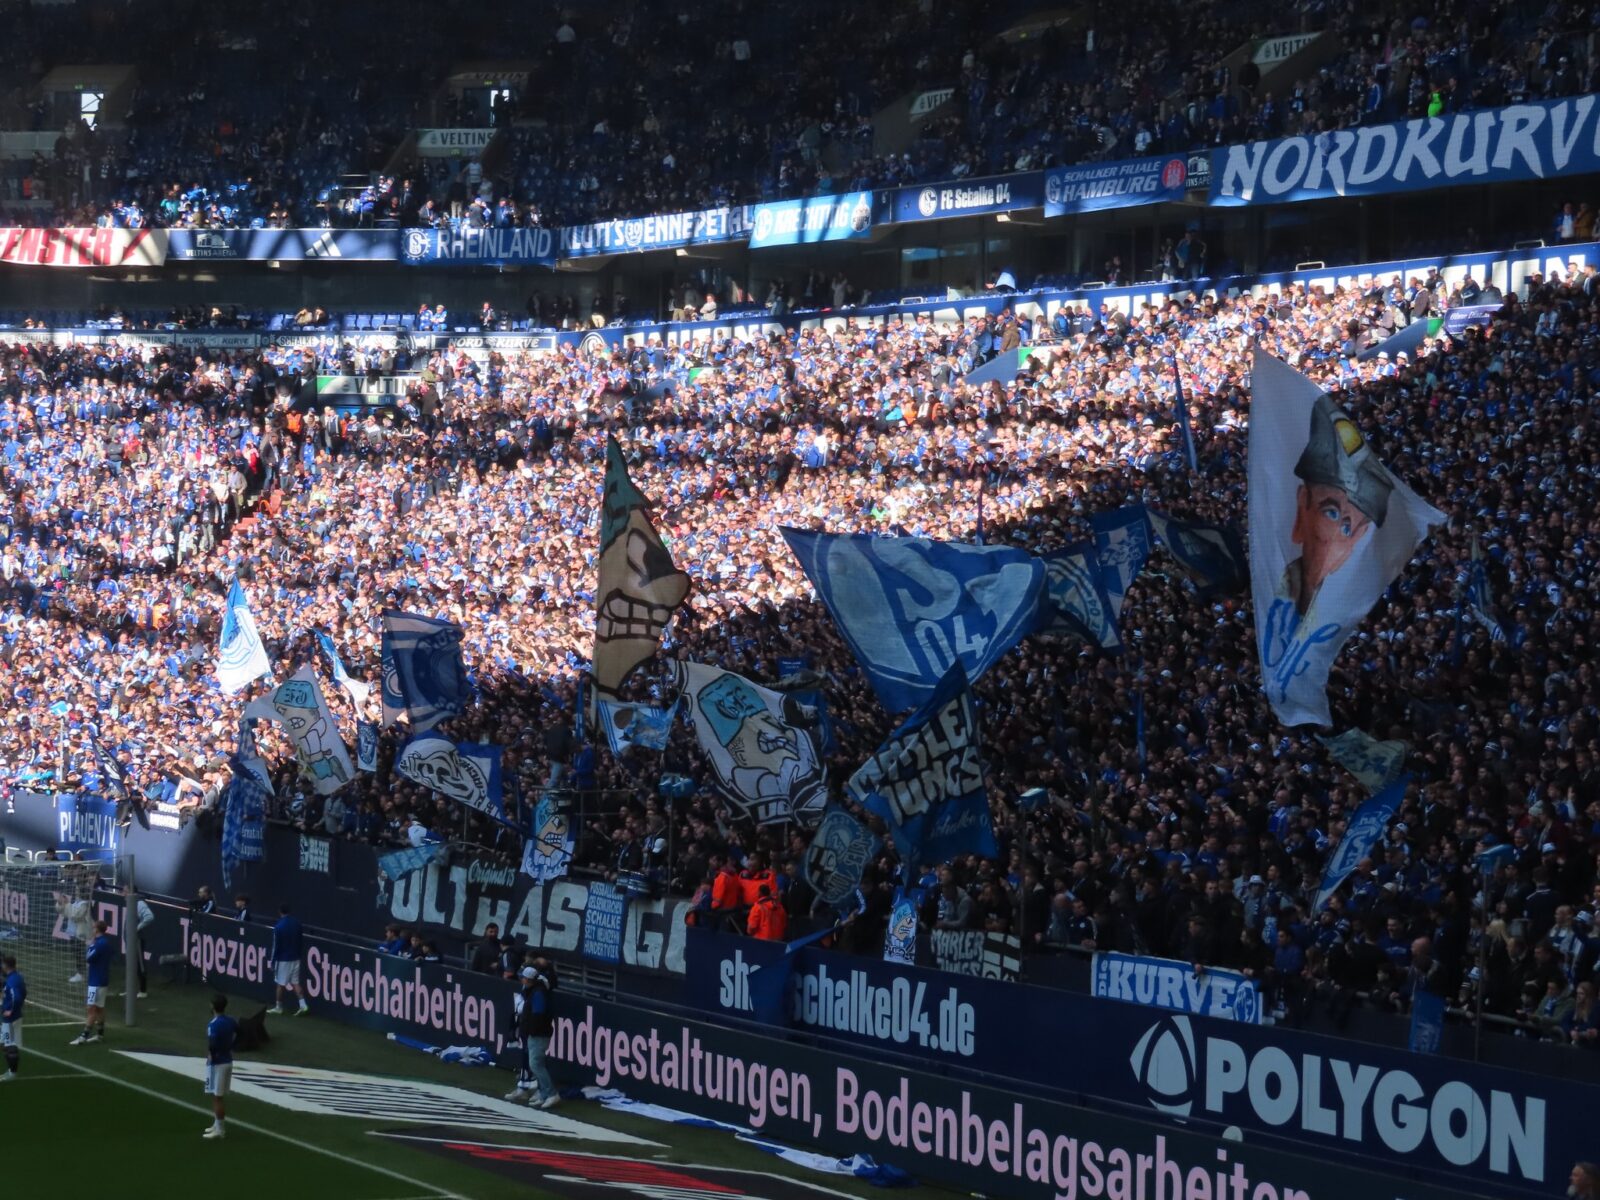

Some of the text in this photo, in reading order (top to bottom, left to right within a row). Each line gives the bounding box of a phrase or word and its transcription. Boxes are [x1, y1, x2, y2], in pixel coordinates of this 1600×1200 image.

[1220, 95, 1600, 201] NORDKURV
[1063, 160, 1161, 183] SCHALKER FILIALE
[940, 183, 1011, 210] FC Schalke 04
[1063, 174, 1159, 202] HAMBURG
[643, 205, 755, 244] ENNEPETAL
[436, 228, 551, 260] RHEINLAND
[450, 337, 540, 349] NORD KURVE
[584, 925, 596, 940] SEIT
[585, 909, 622, 930] SCHALKE
[931, 928, 985, 963] MARLER
[306, 945, 503, 1055] Streicharbeiten,
[1108, 960, 1237, 1021] KURVE
[1205, 1036, 1546, 1183] POLYGON
